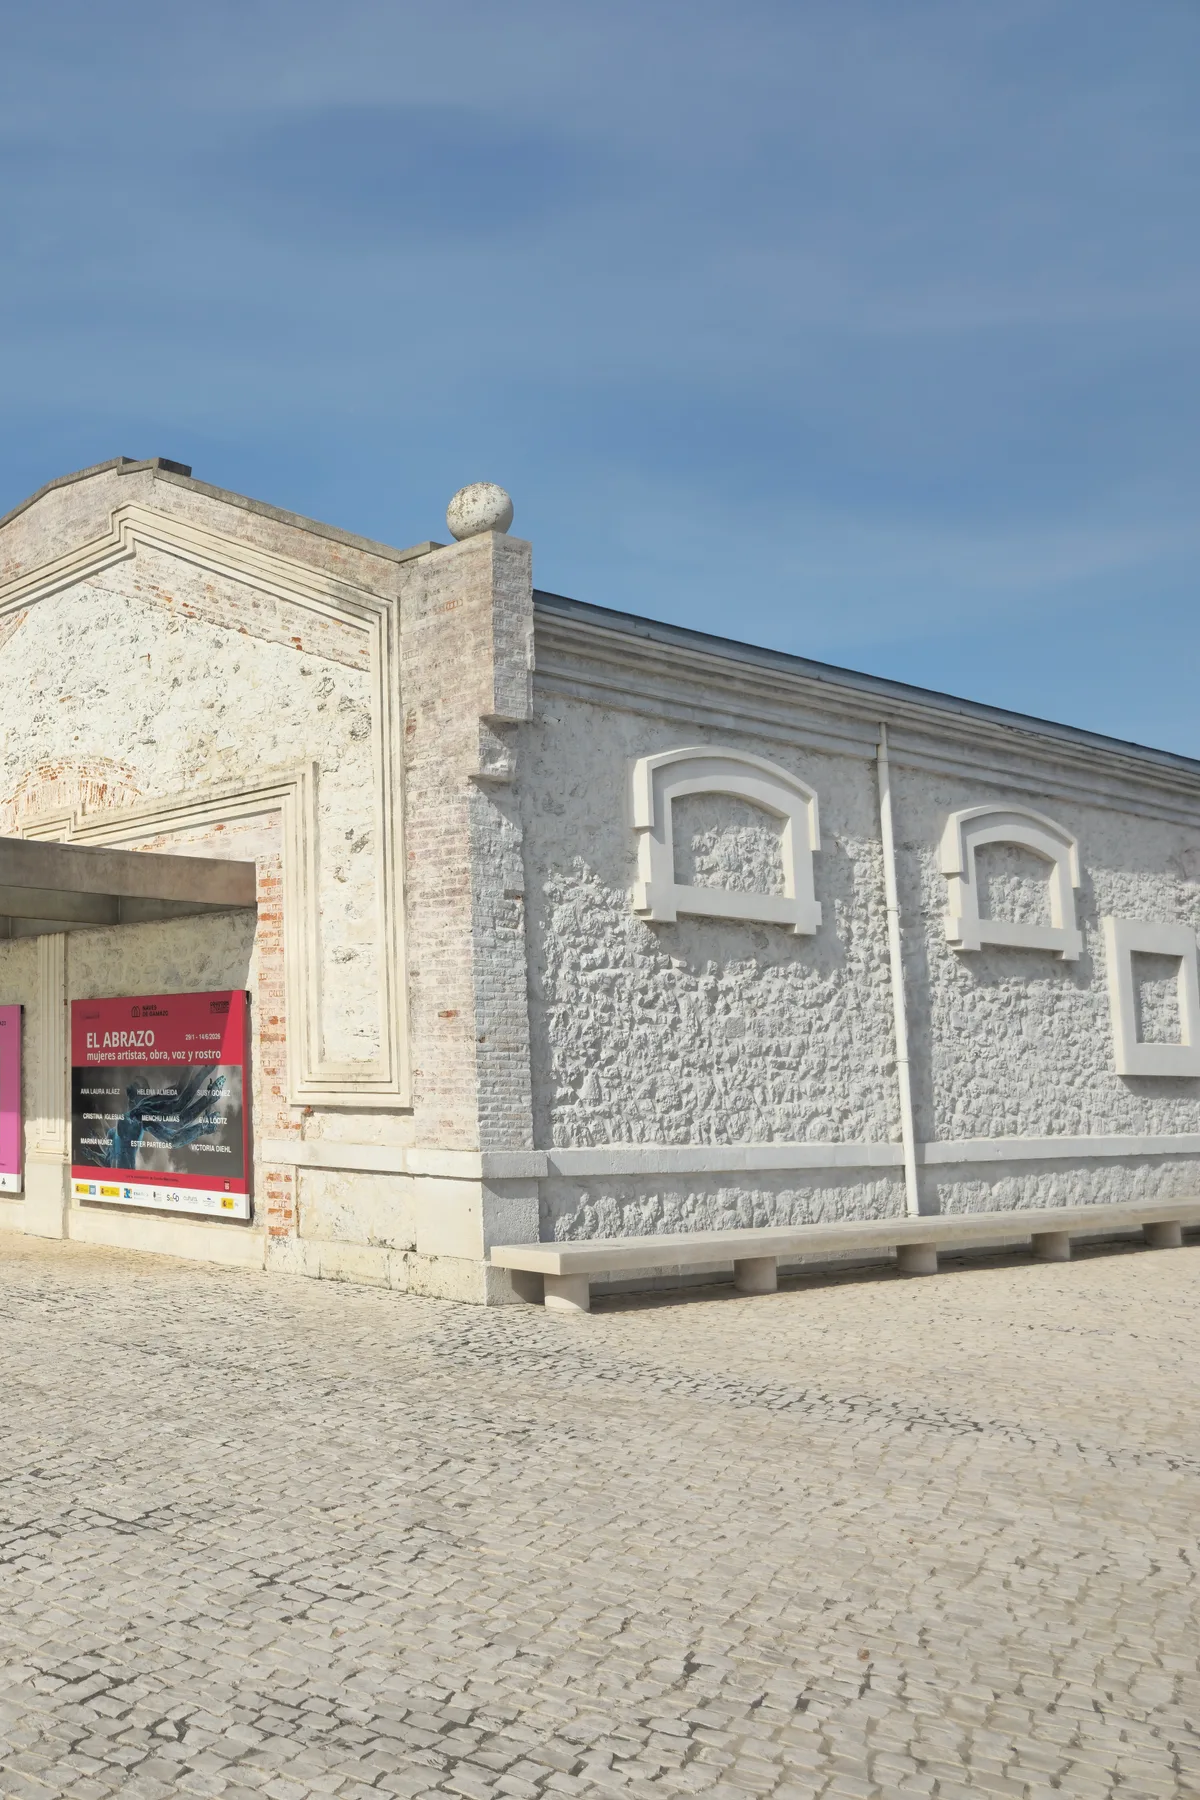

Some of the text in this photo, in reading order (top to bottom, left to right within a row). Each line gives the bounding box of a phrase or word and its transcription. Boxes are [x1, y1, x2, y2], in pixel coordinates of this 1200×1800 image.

[87, 1030, 154, 1048] EL ABRAZO
[87, 1050, 221, 1063] mujeres artistas, obra, voz y rostro
